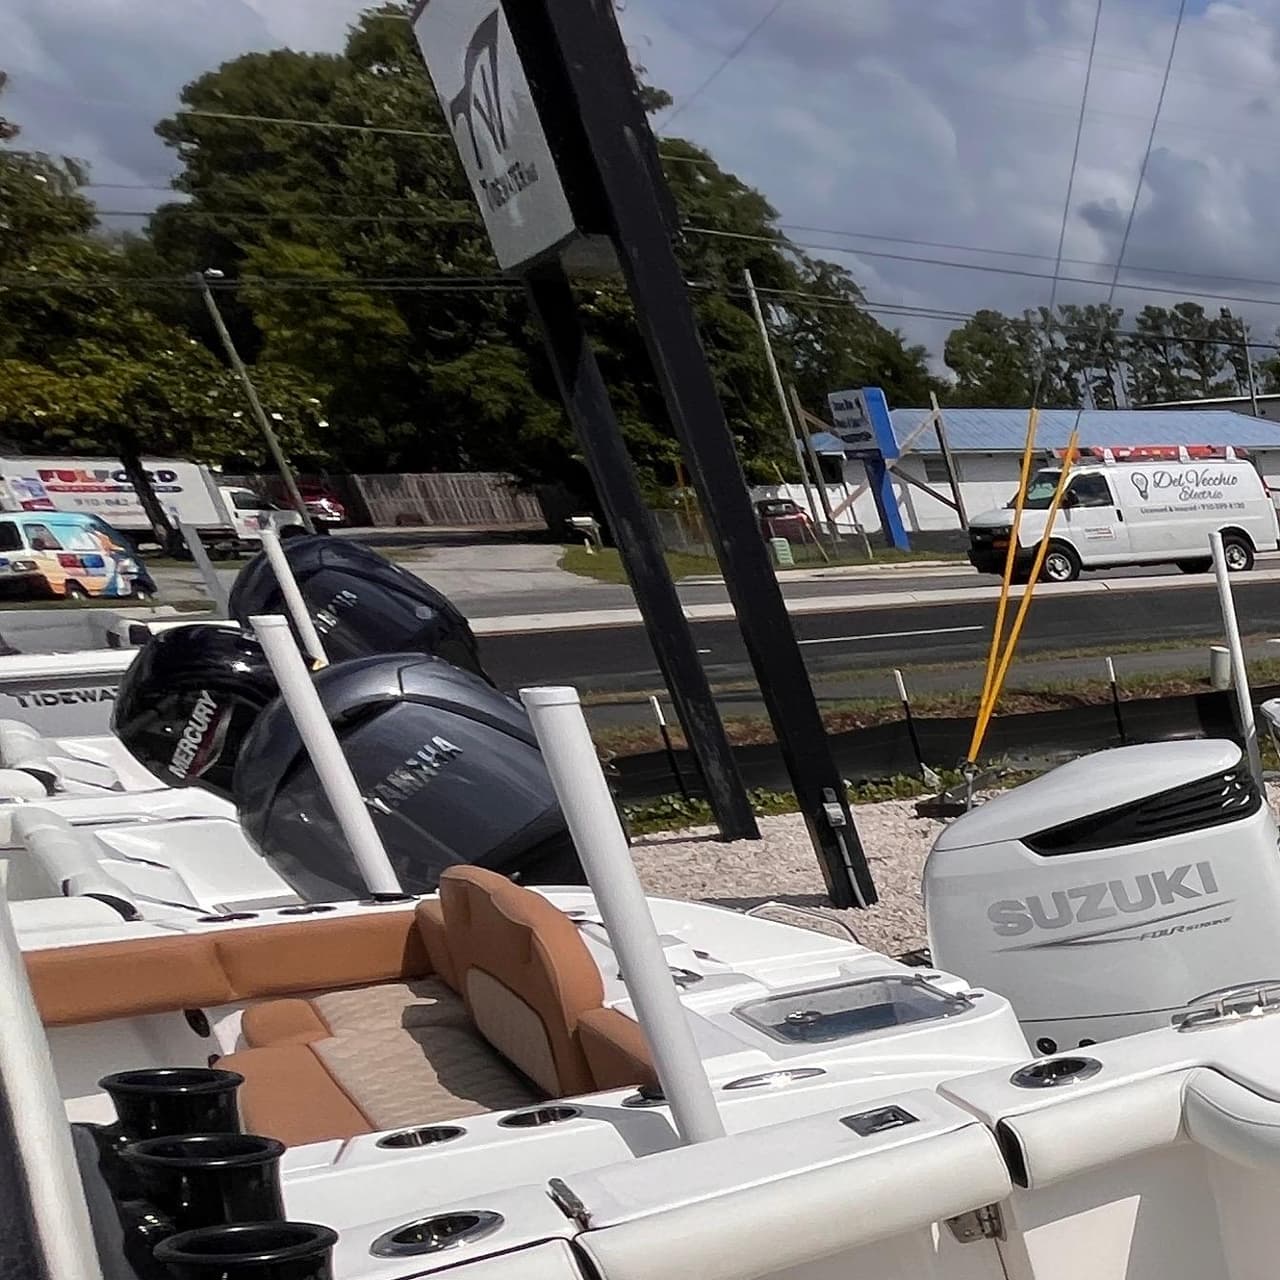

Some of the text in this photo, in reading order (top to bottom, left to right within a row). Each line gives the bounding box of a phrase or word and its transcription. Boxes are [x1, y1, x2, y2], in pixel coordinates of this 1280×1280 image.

[37, 470, 178, 482] FULFOD
[1153, 468, 1238, 488] Del Vecchio
[168, 690, 217, 779] MERCURY
[986, 860, 1220, 938] SUZUKI
